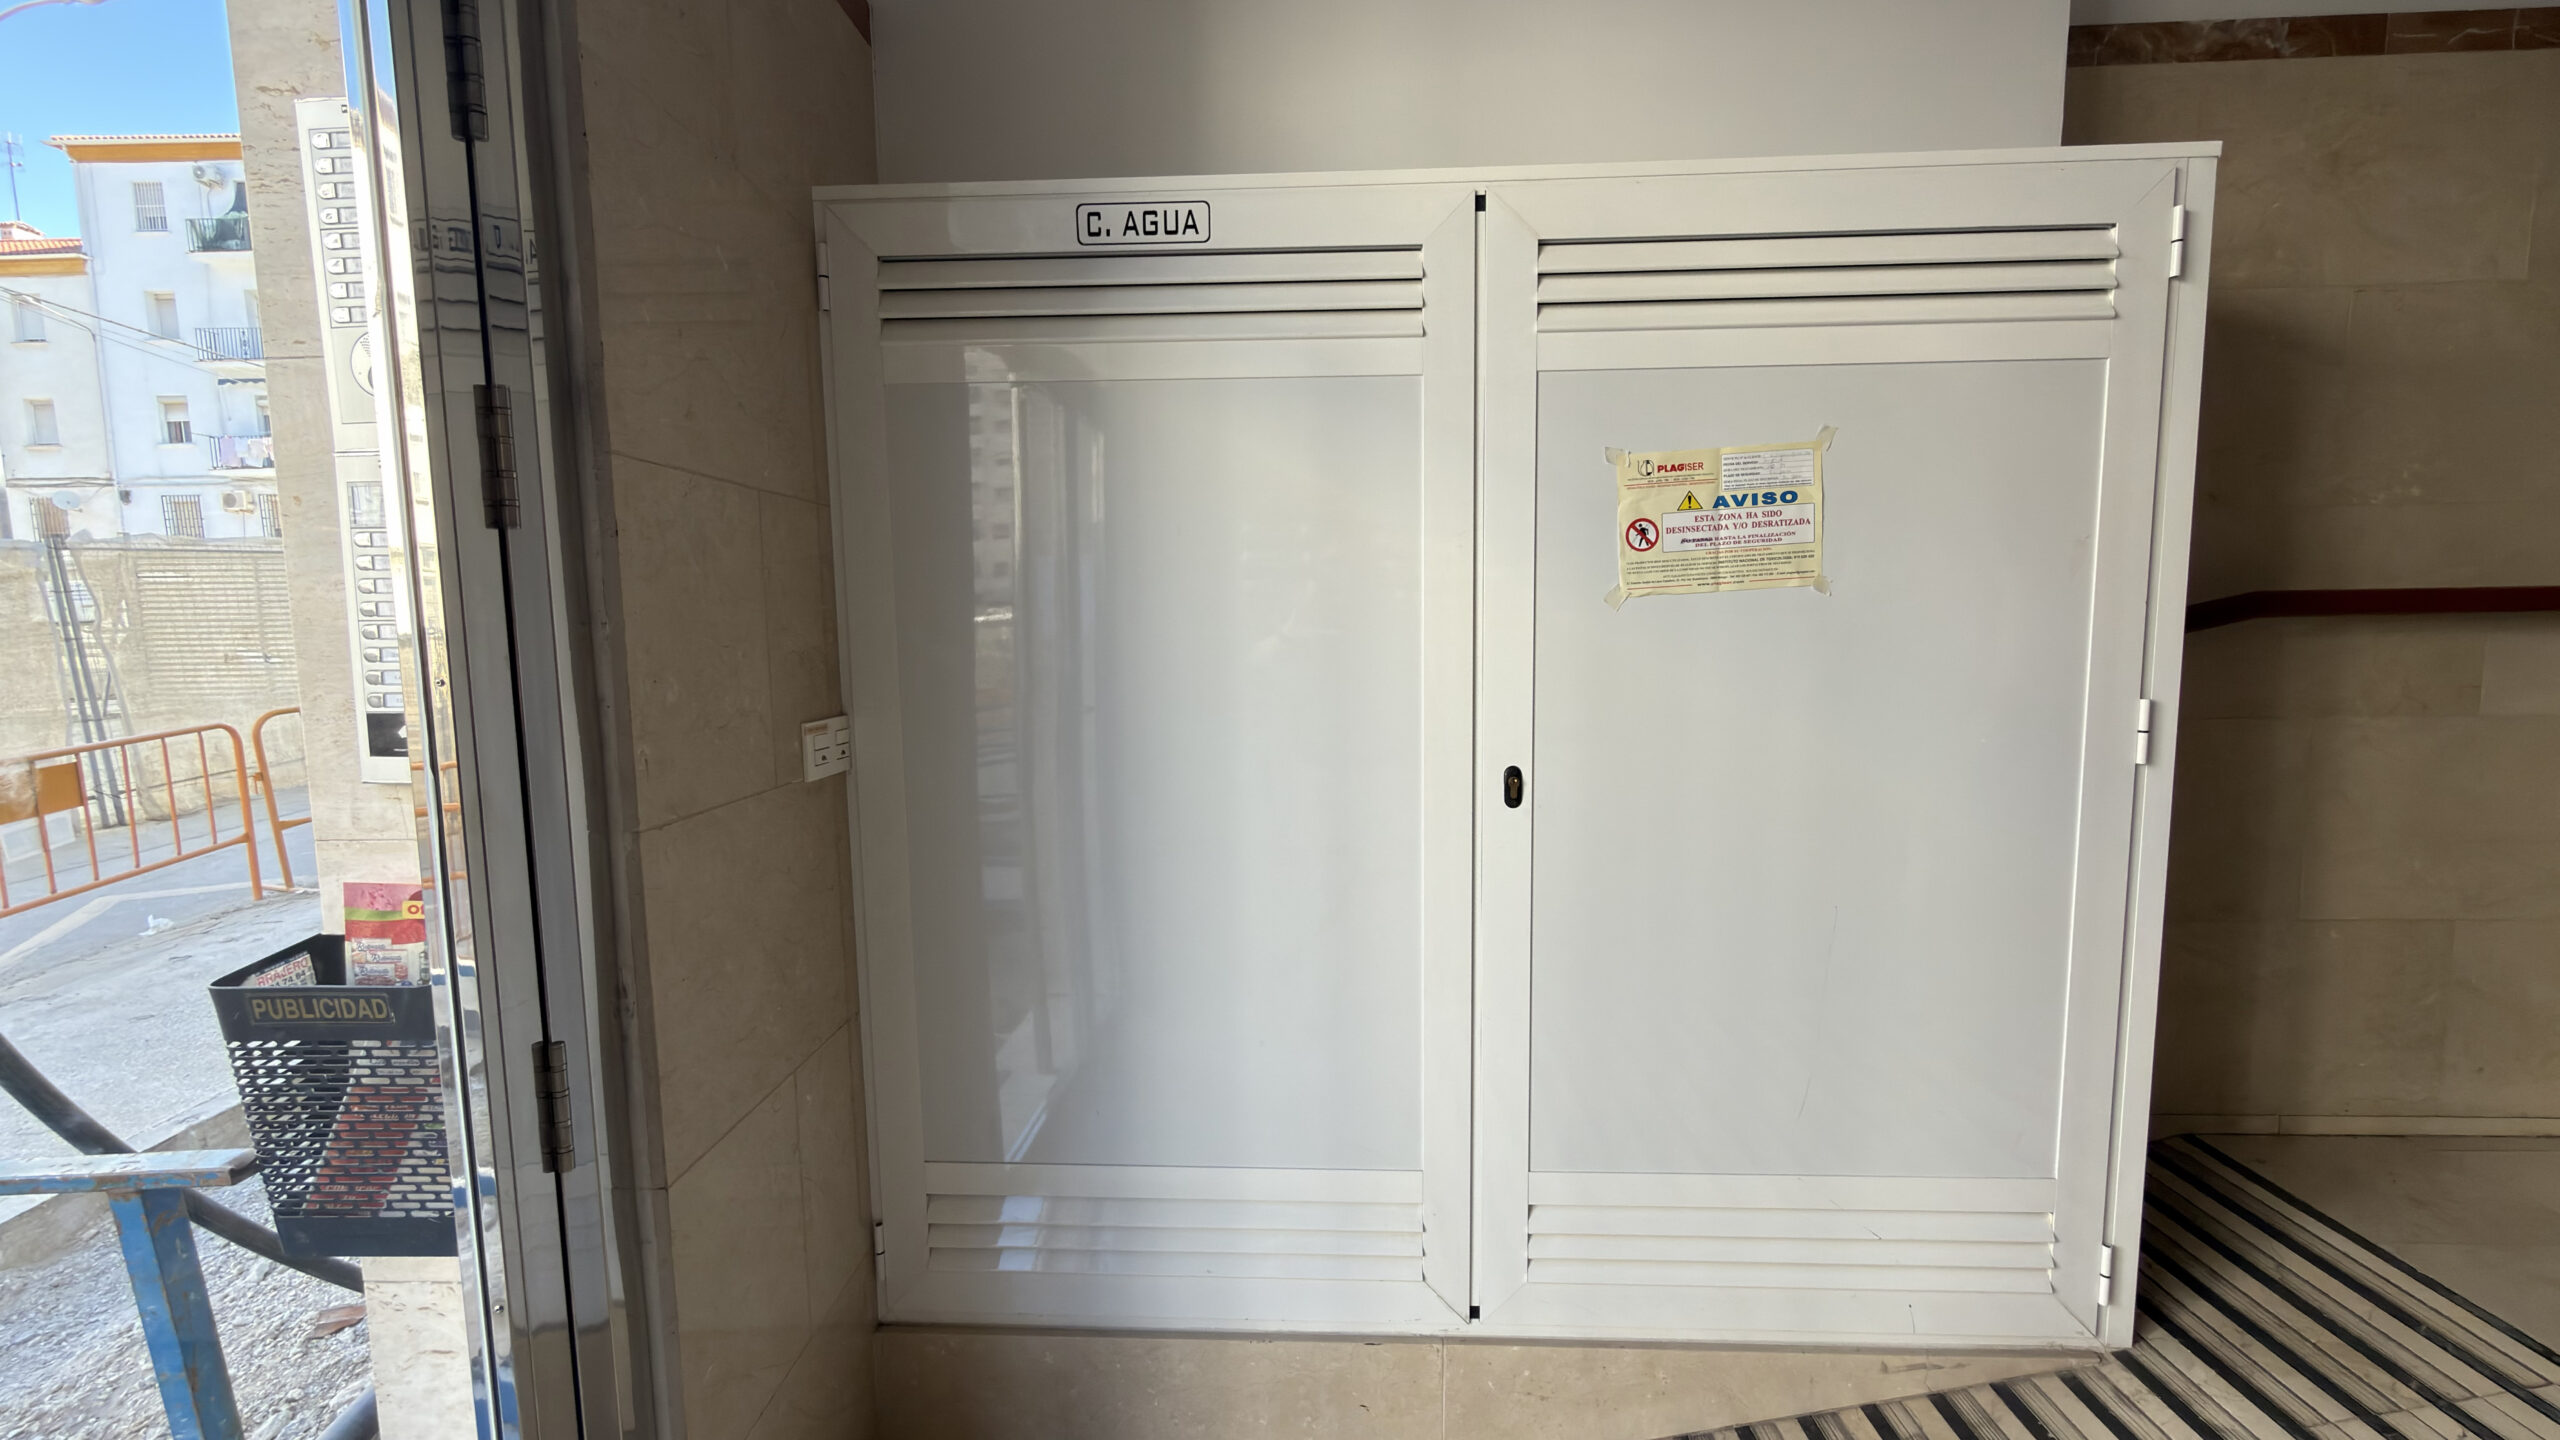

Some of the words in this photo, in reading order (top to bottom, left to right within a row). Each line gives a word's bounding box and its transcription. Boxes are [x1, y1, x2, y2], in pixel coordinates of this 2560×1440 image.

[1087, 211, 1111, 237] C.
[1123, 209, 1199, 236] AGUA
[1657, 462, 1704, 473] PLAGISER
[1712, 490, 1799, 508] AVISO
[1694, 514, 1715, 523] ESTA
[1718, 512, 1742, 521] ZONA
[1746, 511, 1758, 519] HA
[1762, 509, 1783, 518] SIDO
[1666, 523, 1730, 534] DESINSECTADA
[1733, 522, 1748, 530] Y/O
[1752, 517, 1811, 529] DESRATIZADA
[1714, 534, 1737, 542] HASTA
[1743, 537, 1783, 545] SEGURIDAD
[252, 998, 388, 1019] PUBLICIDAD
